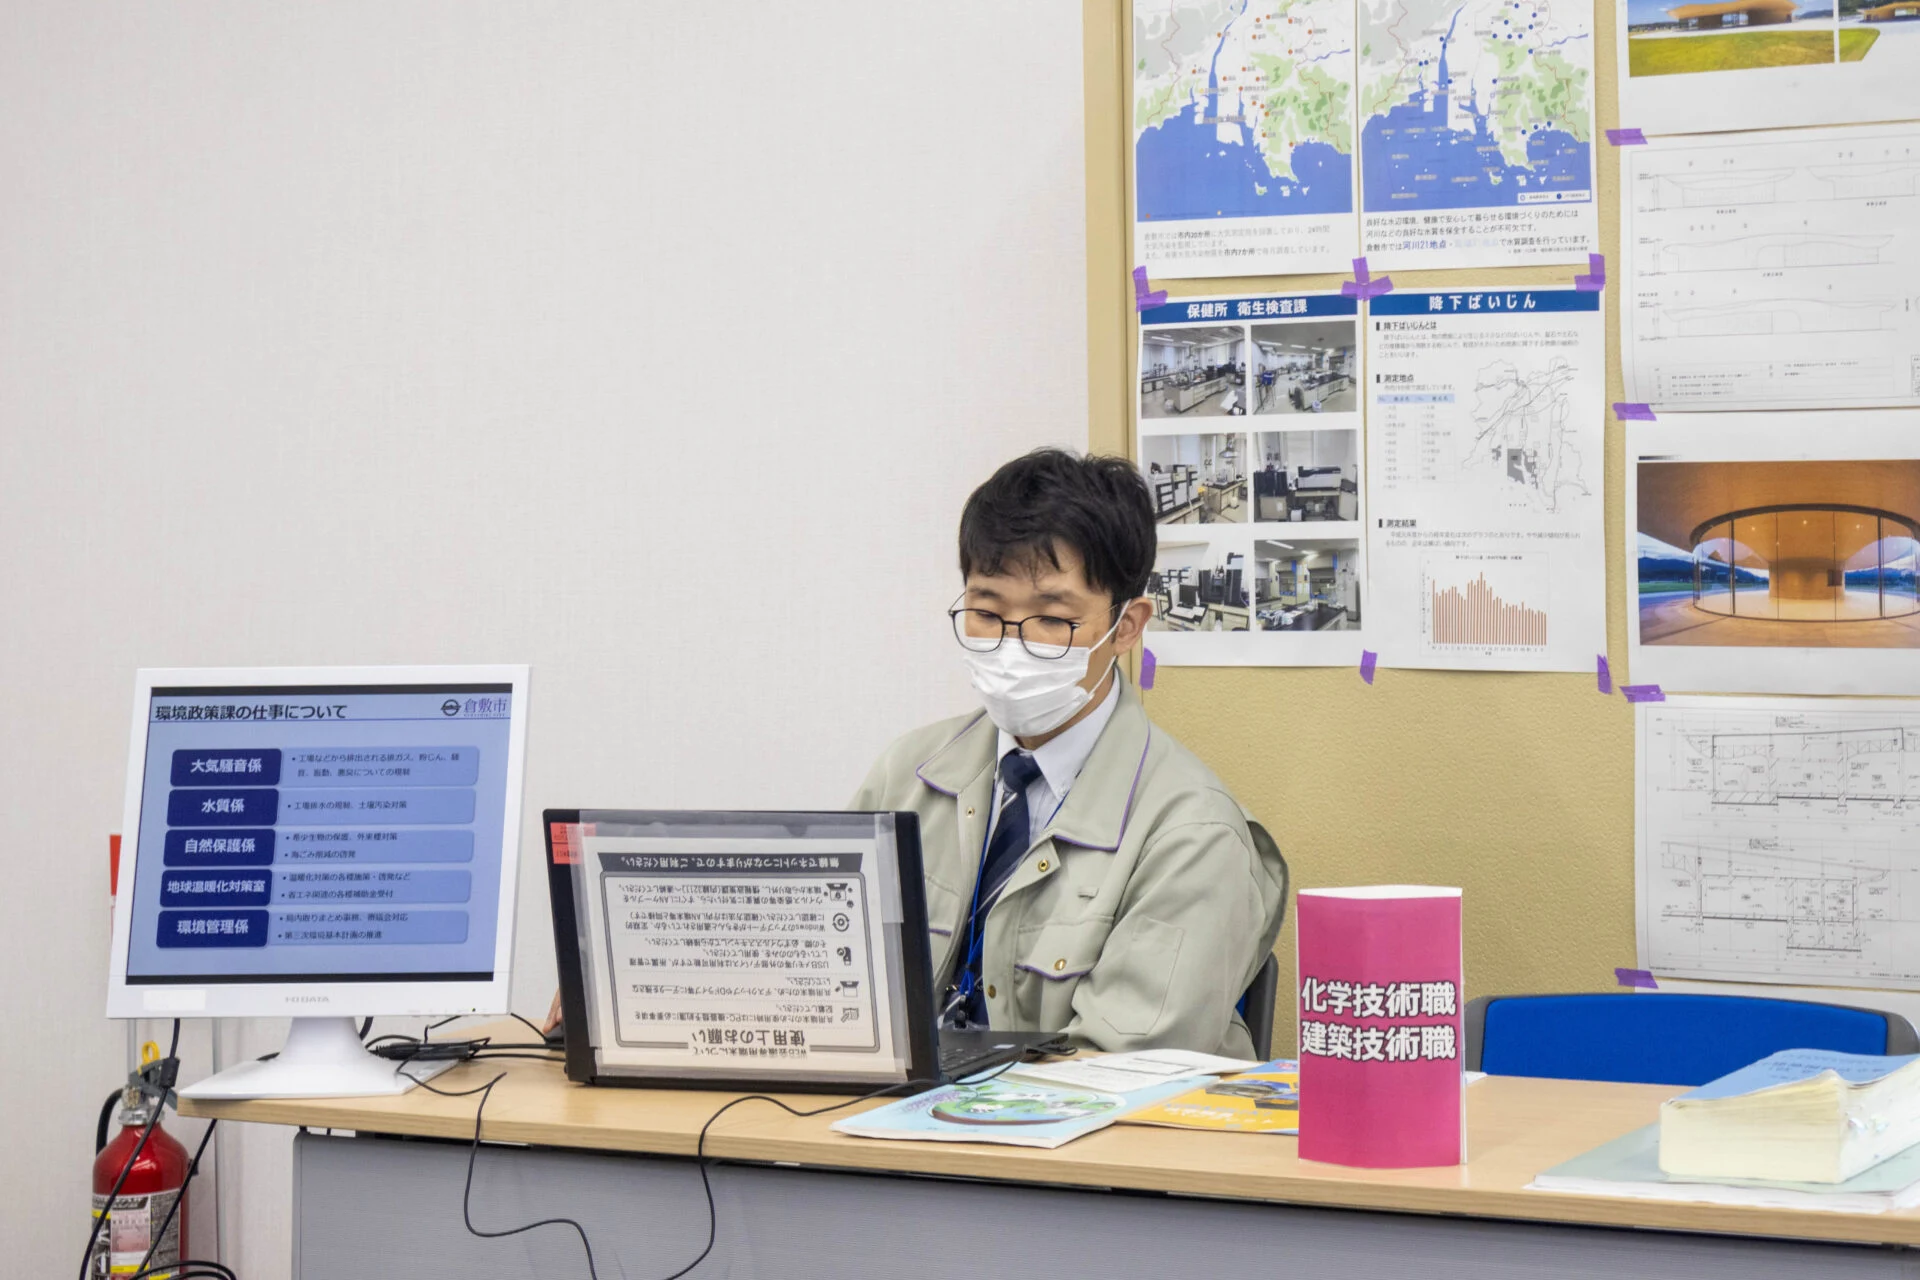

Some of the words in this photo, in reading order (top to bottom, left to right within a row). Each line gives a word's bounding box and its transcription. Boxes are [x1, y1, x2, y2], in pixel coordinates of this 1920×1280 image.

[1187, 303, 1227, 319] 保健所
[1237, 298, 1308, 317] 衛生検査課
[1428, 294, 1536, 311] 降下ばいじん
[1383, 321, 1437, 331] 降下ばいじんとは
[1384, 374, 1415, 383] 測定地点
[1386, 519, 1417, 528] 測定結果
[155, 703, 348, 722] 環境政策課の仕事について
[464, 697, 507, 714] 倉敷市
[191, 757, 262, 774] 大気騒音係
[202, 798, 245, 814] 水質係
[184, 837, 256, 854] 自然保護係
[167, 879, 265, 894] 地球温暖化対策室
[177, 918, 249, 936] 環境管理係
[1301, 977, 1456, 1018] 化学技術職
[692, 1030, 806, 1045] 使用上のお願い
[1301, 1021, 1456, 1061] 建築技術職
